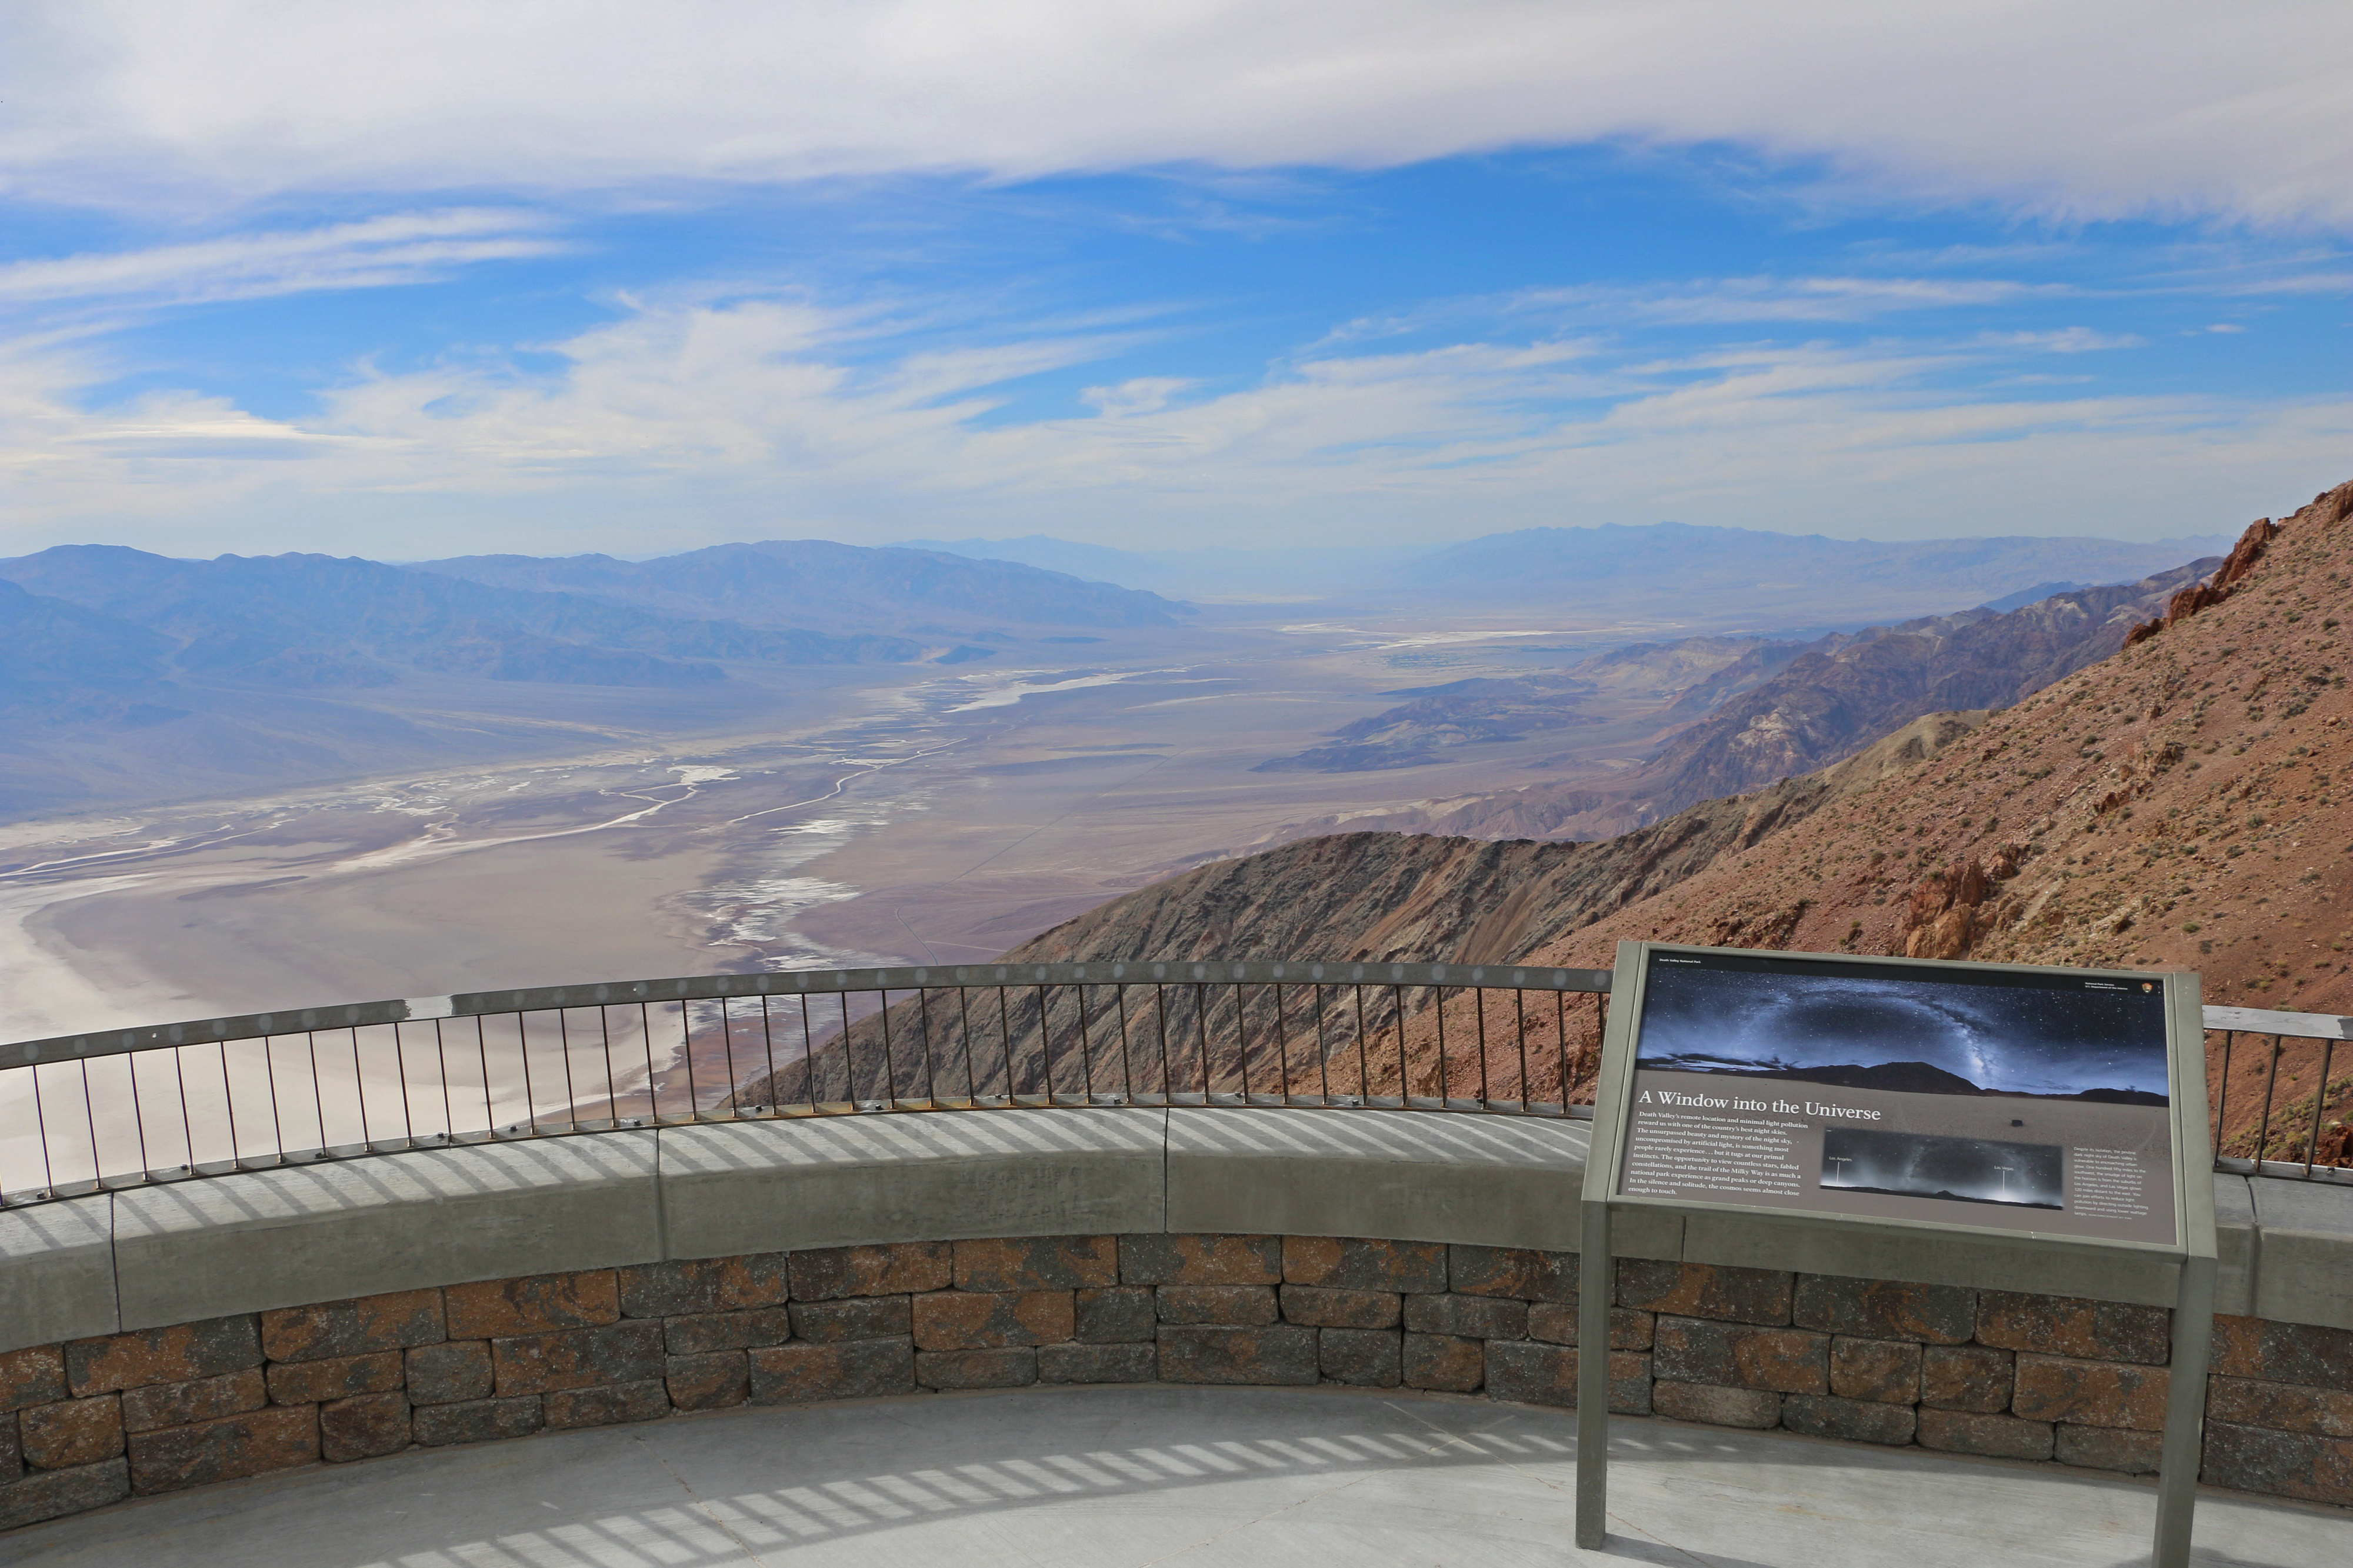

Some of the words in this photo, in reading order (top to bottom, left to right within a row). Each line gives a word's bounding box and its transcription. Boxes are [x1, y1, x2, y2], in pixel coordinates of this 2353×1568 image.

[1638, 1090, 1652, 1103] A
[1658, 1091, 1729, 1108] Window
[1733, 1096, 1767, 1111] into
[1772, 1099, 1799, 1113] the
[1805, 1102, 1881, 1120] Universe
